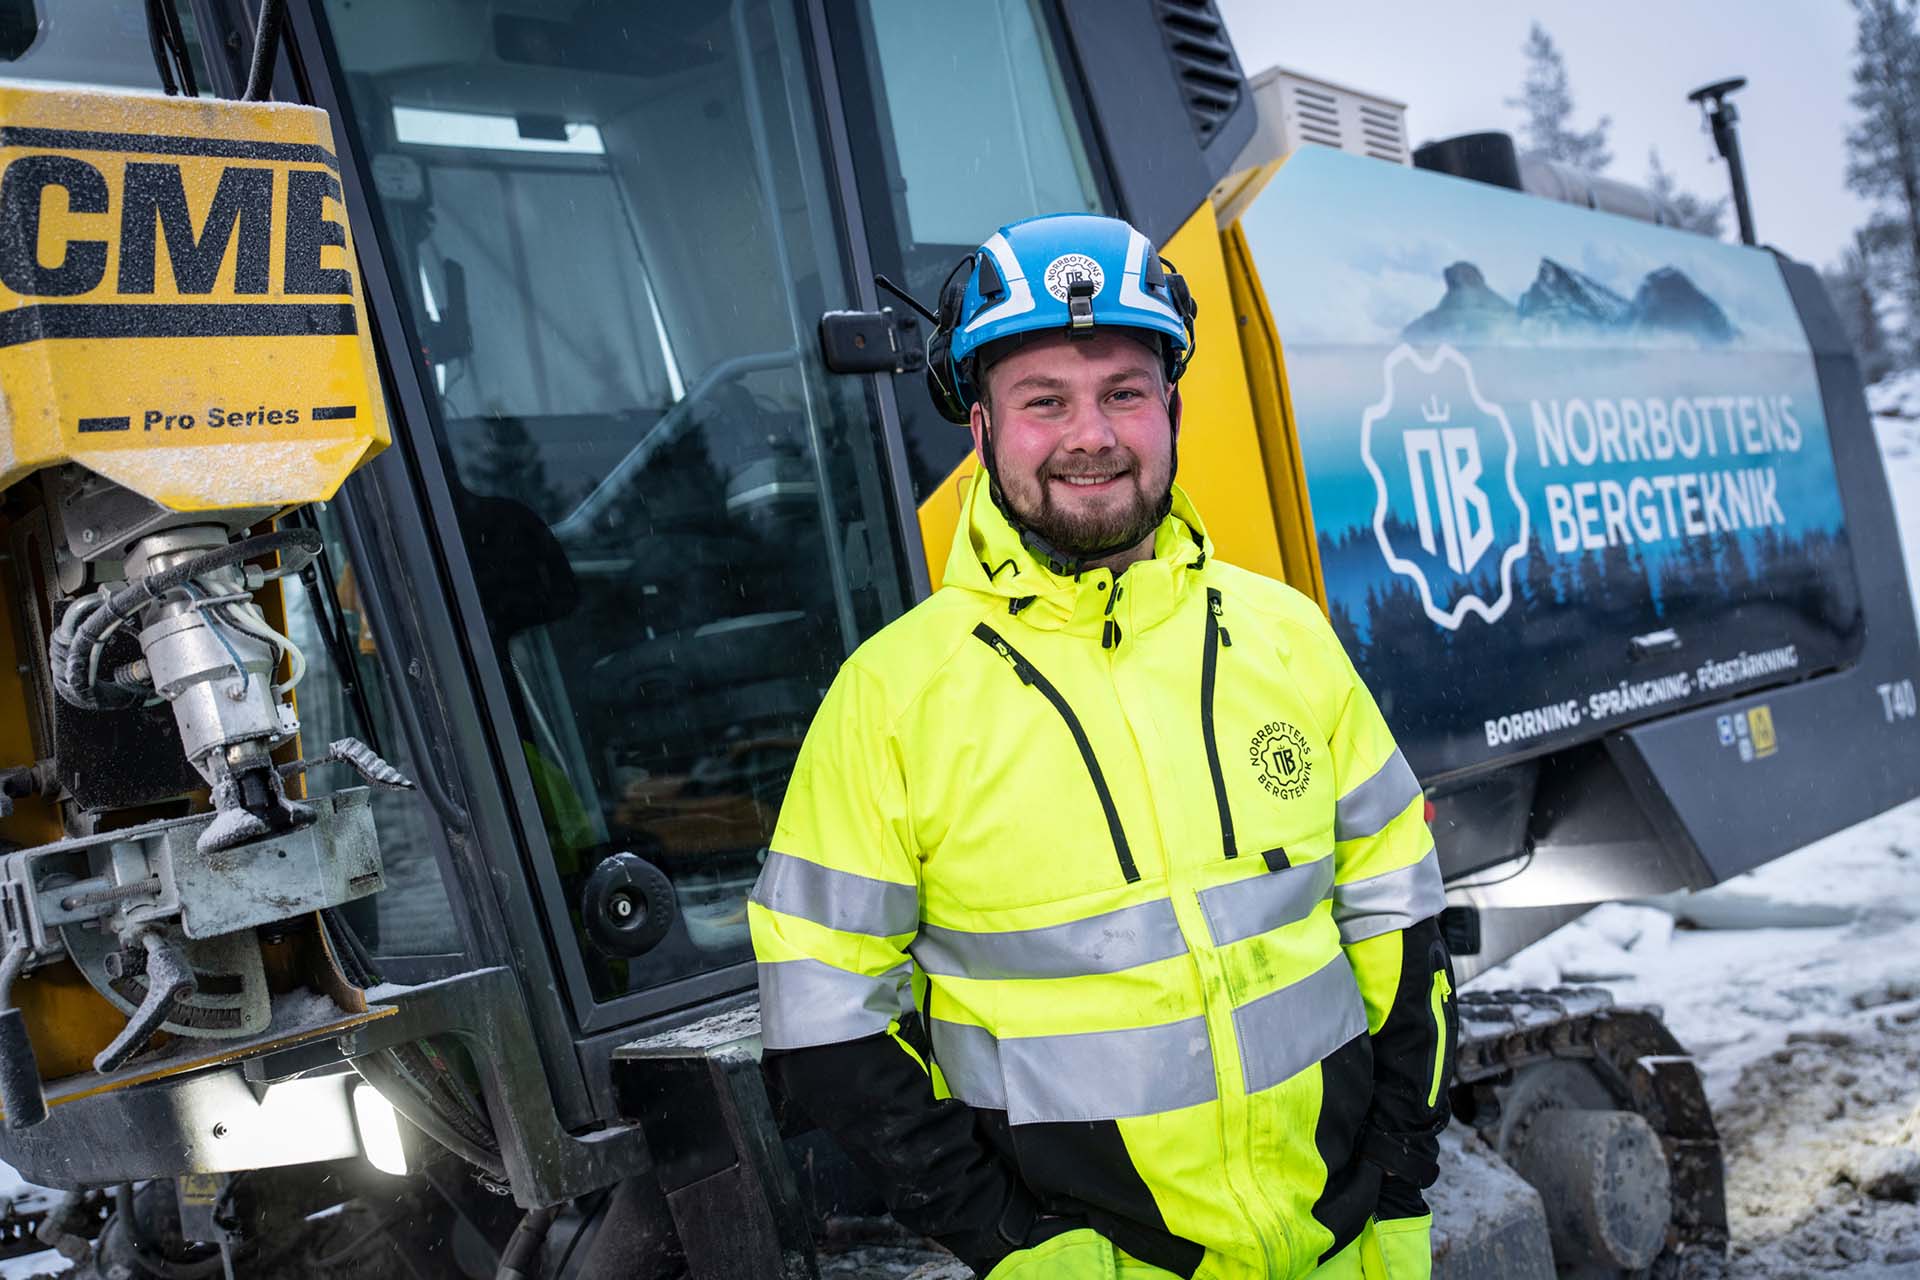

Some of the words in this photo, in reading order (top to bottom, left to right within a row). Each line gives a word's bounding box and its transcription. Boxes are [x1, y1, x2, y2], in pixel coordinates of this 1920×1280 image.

[0, 155, 354, 297] CME
[1048, 256, 1101, 281] NORRBOTTENS
[144, 410, 195, 431] Pro
[207, 405, 300, 427] Series
[1530, 393, 1802, 468] NORRBOTTENS
[1545, 467, 1785, 554] BERGTEKNIK
[1485, 700, 1581, 747] BORRNING
[1589, 672, 1691, 720] SPRÄNGNING
[1249, 721, 1311, 766] NORRBOTTENS
[1258, 761, 1312, 800] BERGTEKNIK
